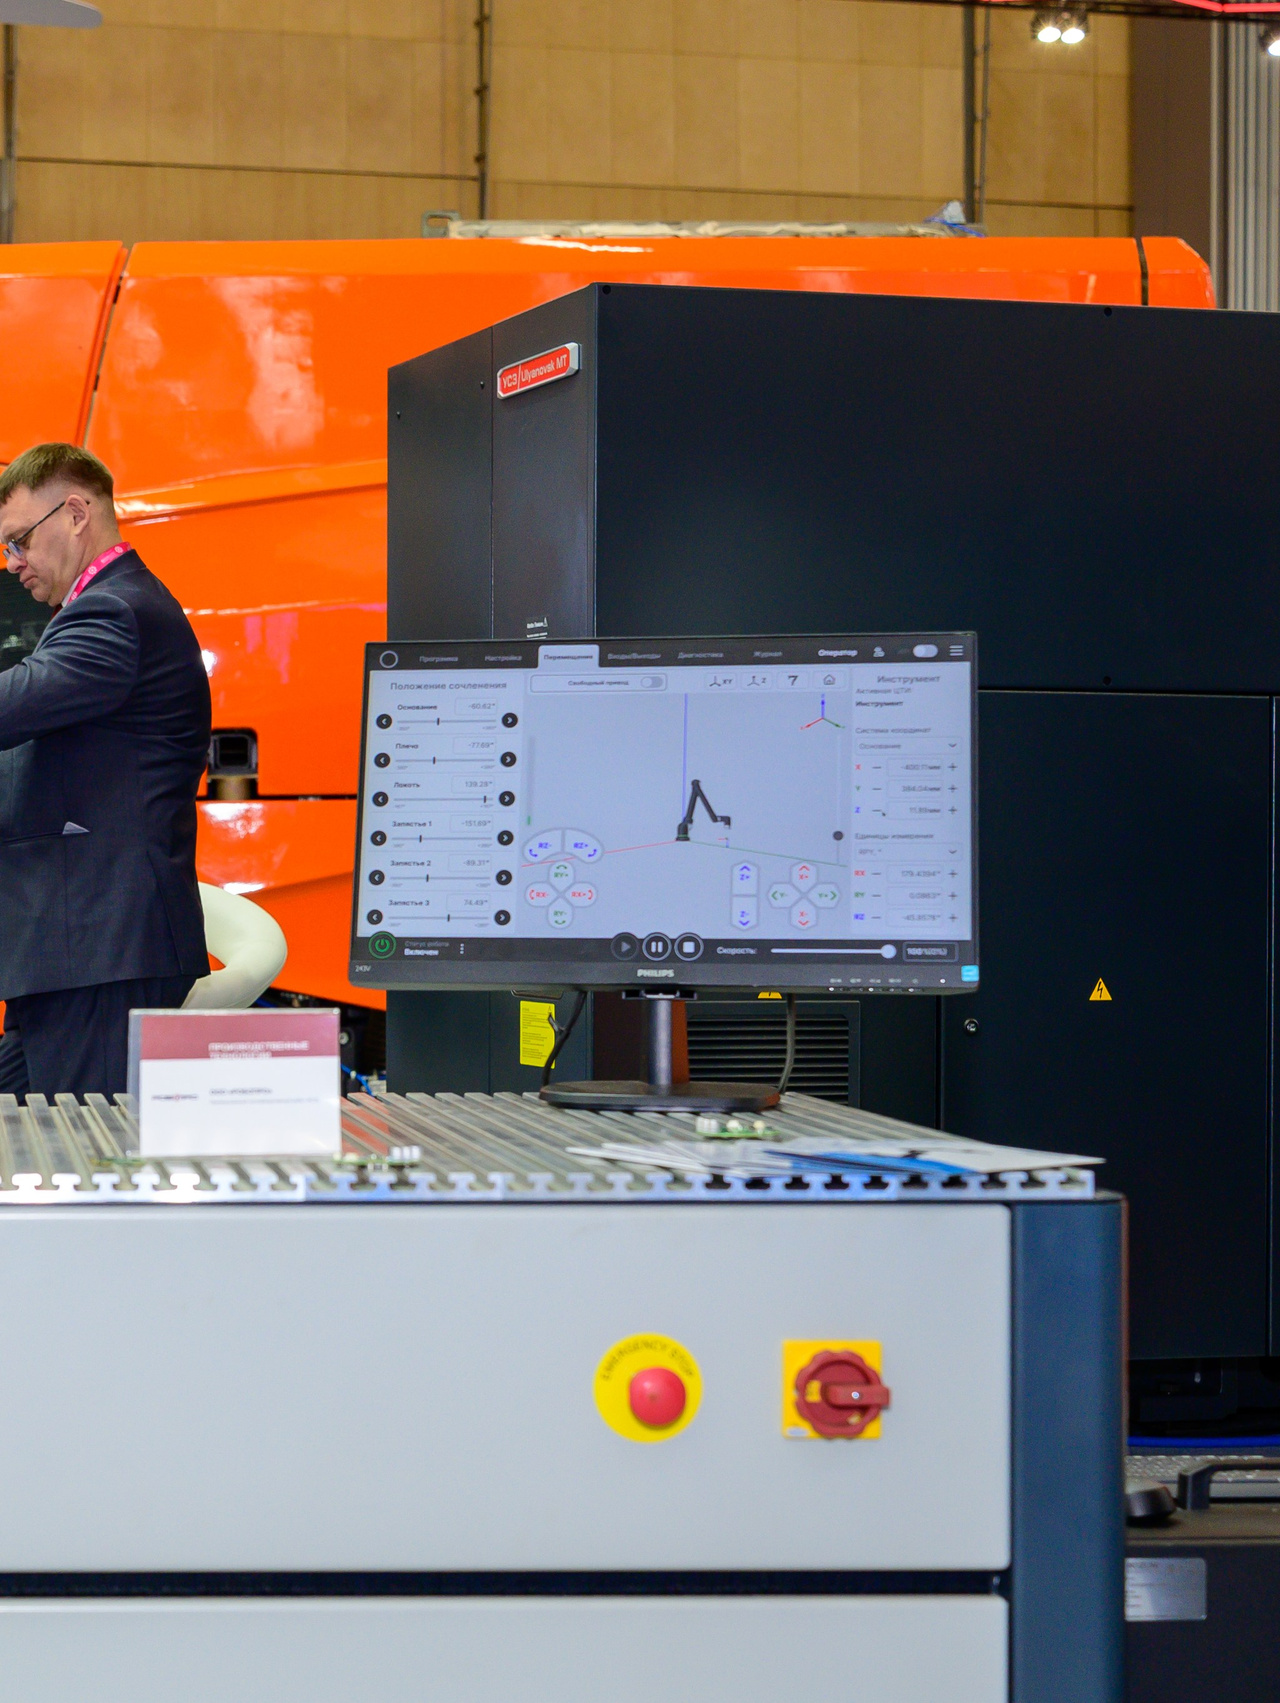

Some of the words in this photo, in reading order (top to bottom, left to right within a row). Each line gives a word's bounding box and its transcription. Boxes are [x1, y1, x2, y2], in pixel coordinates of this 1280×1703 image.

[520, 360, 555, 382] Ulyanovsk
[556, 354, 568, 369] MT
[817, 648, 858, 658] Оператор
[877, 675, 940, 684] Инструмент
[390, 682, 447, 691] Положение
[855, 700, 904, 709] Инструмент
[854, 869, 866, 877] RX
[403, 948, 439, 956] Включен
[636, 968, 675, 978] PHILIPS
[668, 1347, 695, 1379] STOP
